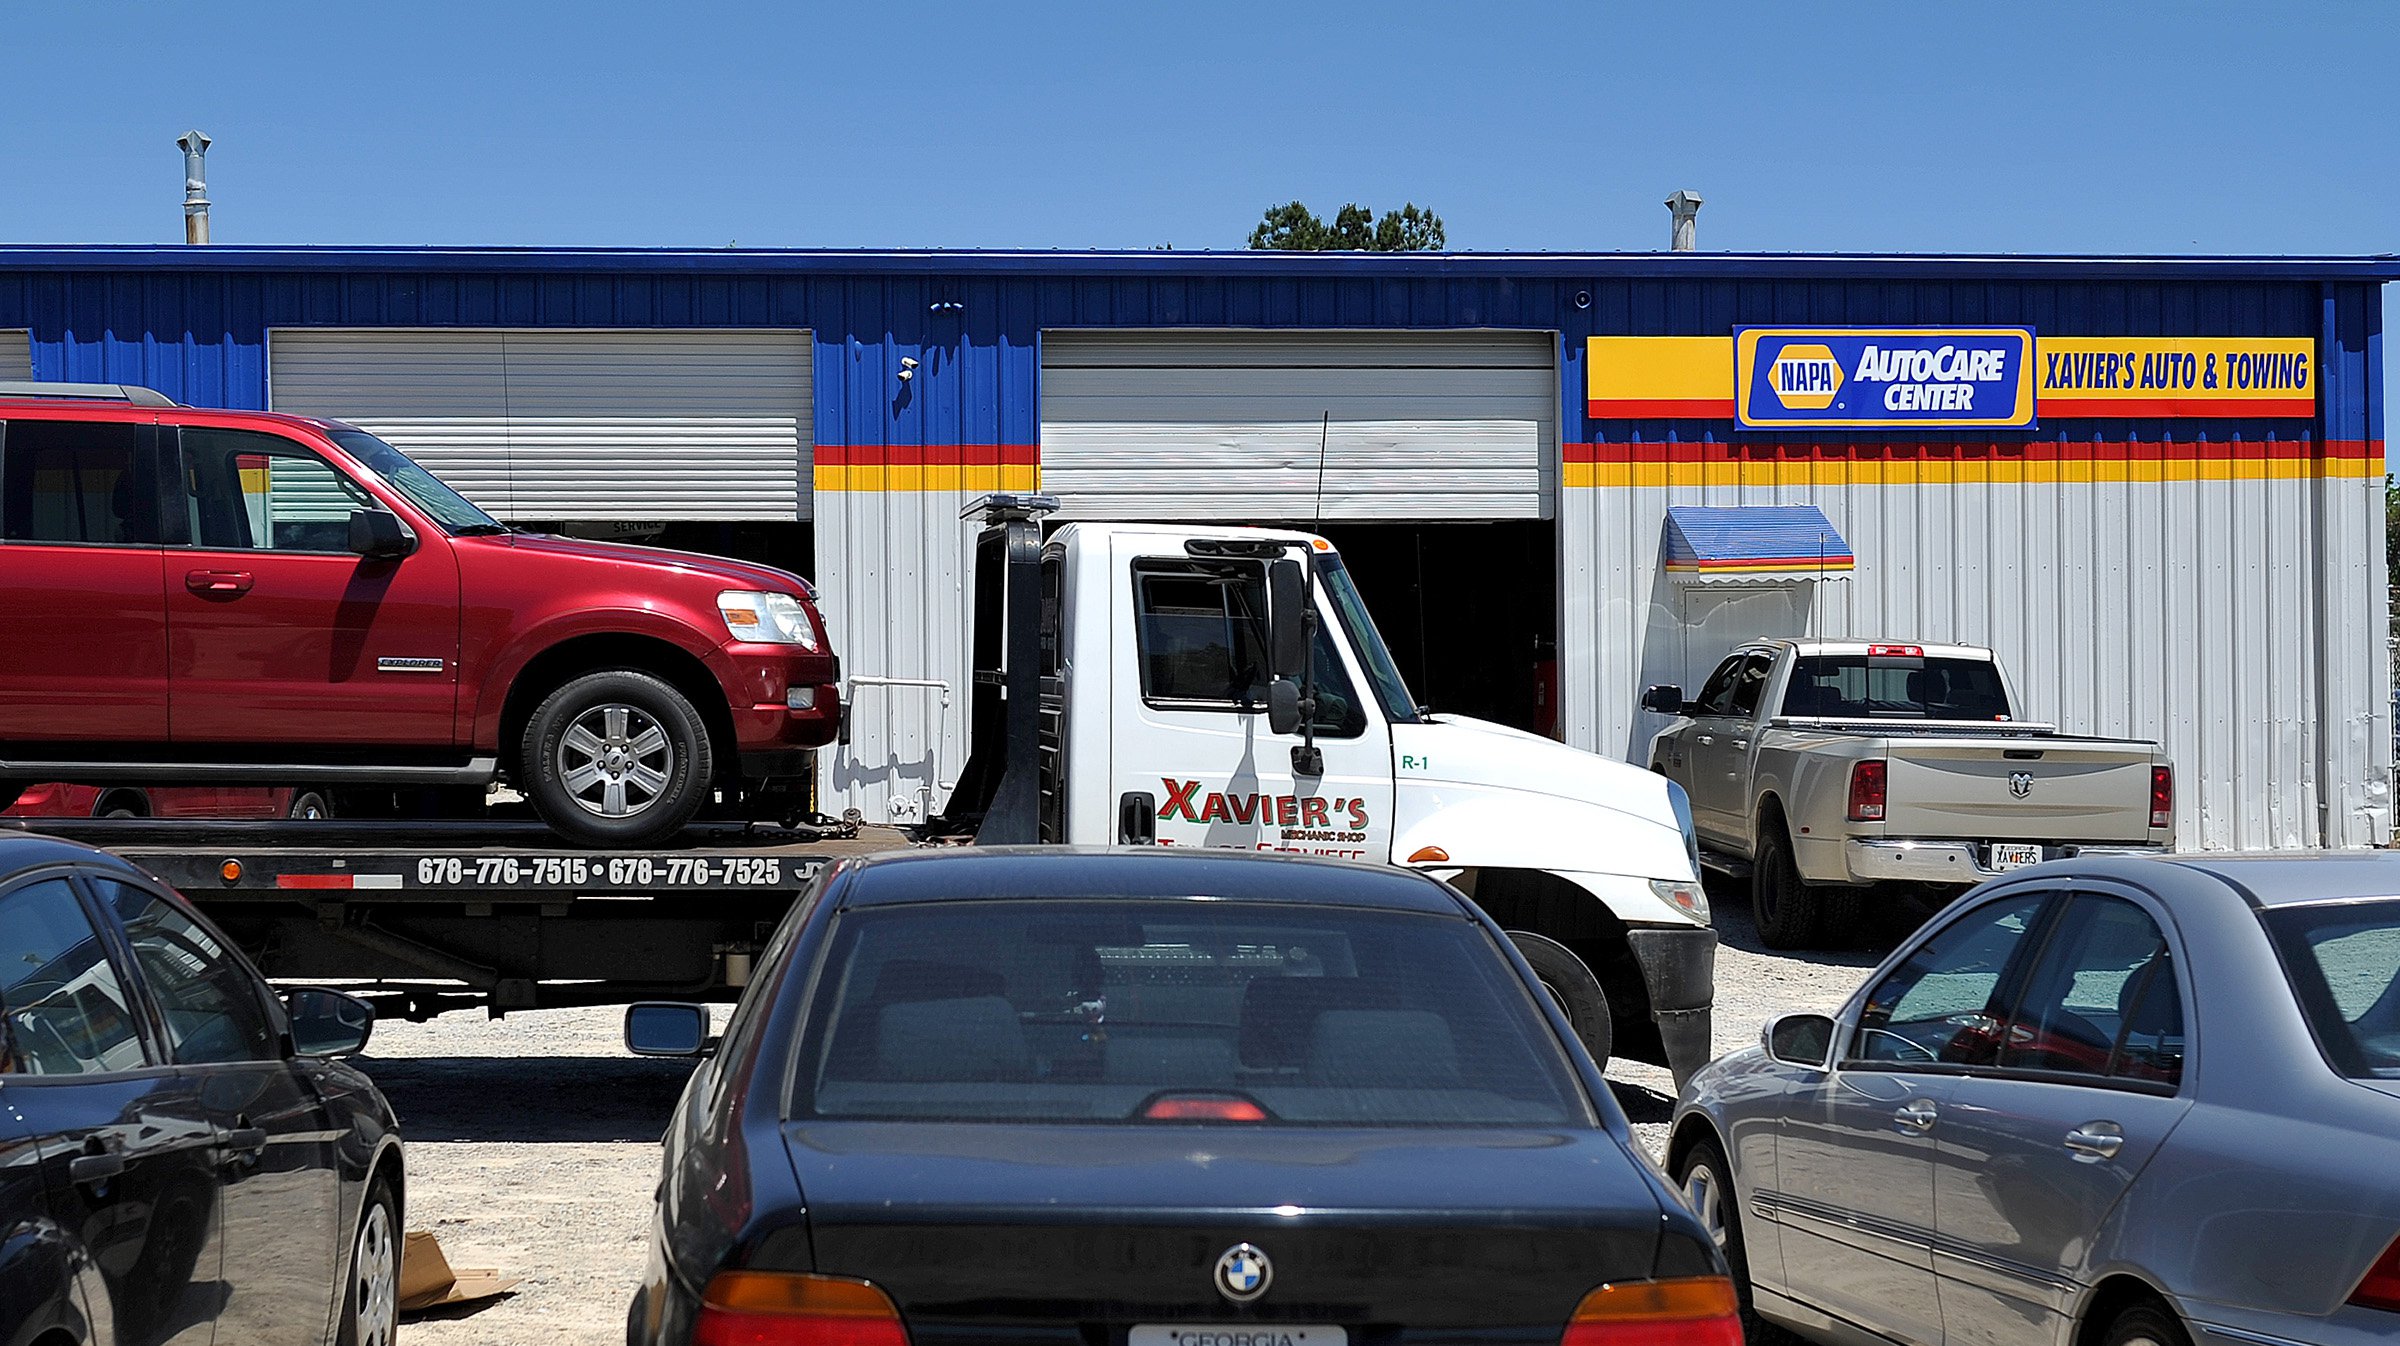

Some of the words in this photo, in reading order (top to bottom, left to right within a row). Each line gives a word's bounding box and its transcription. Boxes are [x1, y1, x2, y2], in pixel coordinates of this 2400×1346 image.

[1781, 362, 1833, 392] NAPA
[2044, 352, 2136, 389] XAVIER'S
[2140, 353, 2197, 389] AUTO
[2203, 353, 2218, 389] &
[2226, 352, 2308, 390] TOWING
[1883, 383, 1974, 411] CENTER
[613, 521, 662, 533] SERVICE
[1402, 755, 1428, 770] R-1
[1157, 777, 1370, 831] XAVIER'S
[1280, 829, 1336, 842] MECHANIC
[1337, 831, 1366, 843] SHOP
[417, 857, 588, 885] 678-776-7515
[608, 857, 781, 885] 678-776-7525
[1180, 1331, 1294, 1346] GEORGIA
